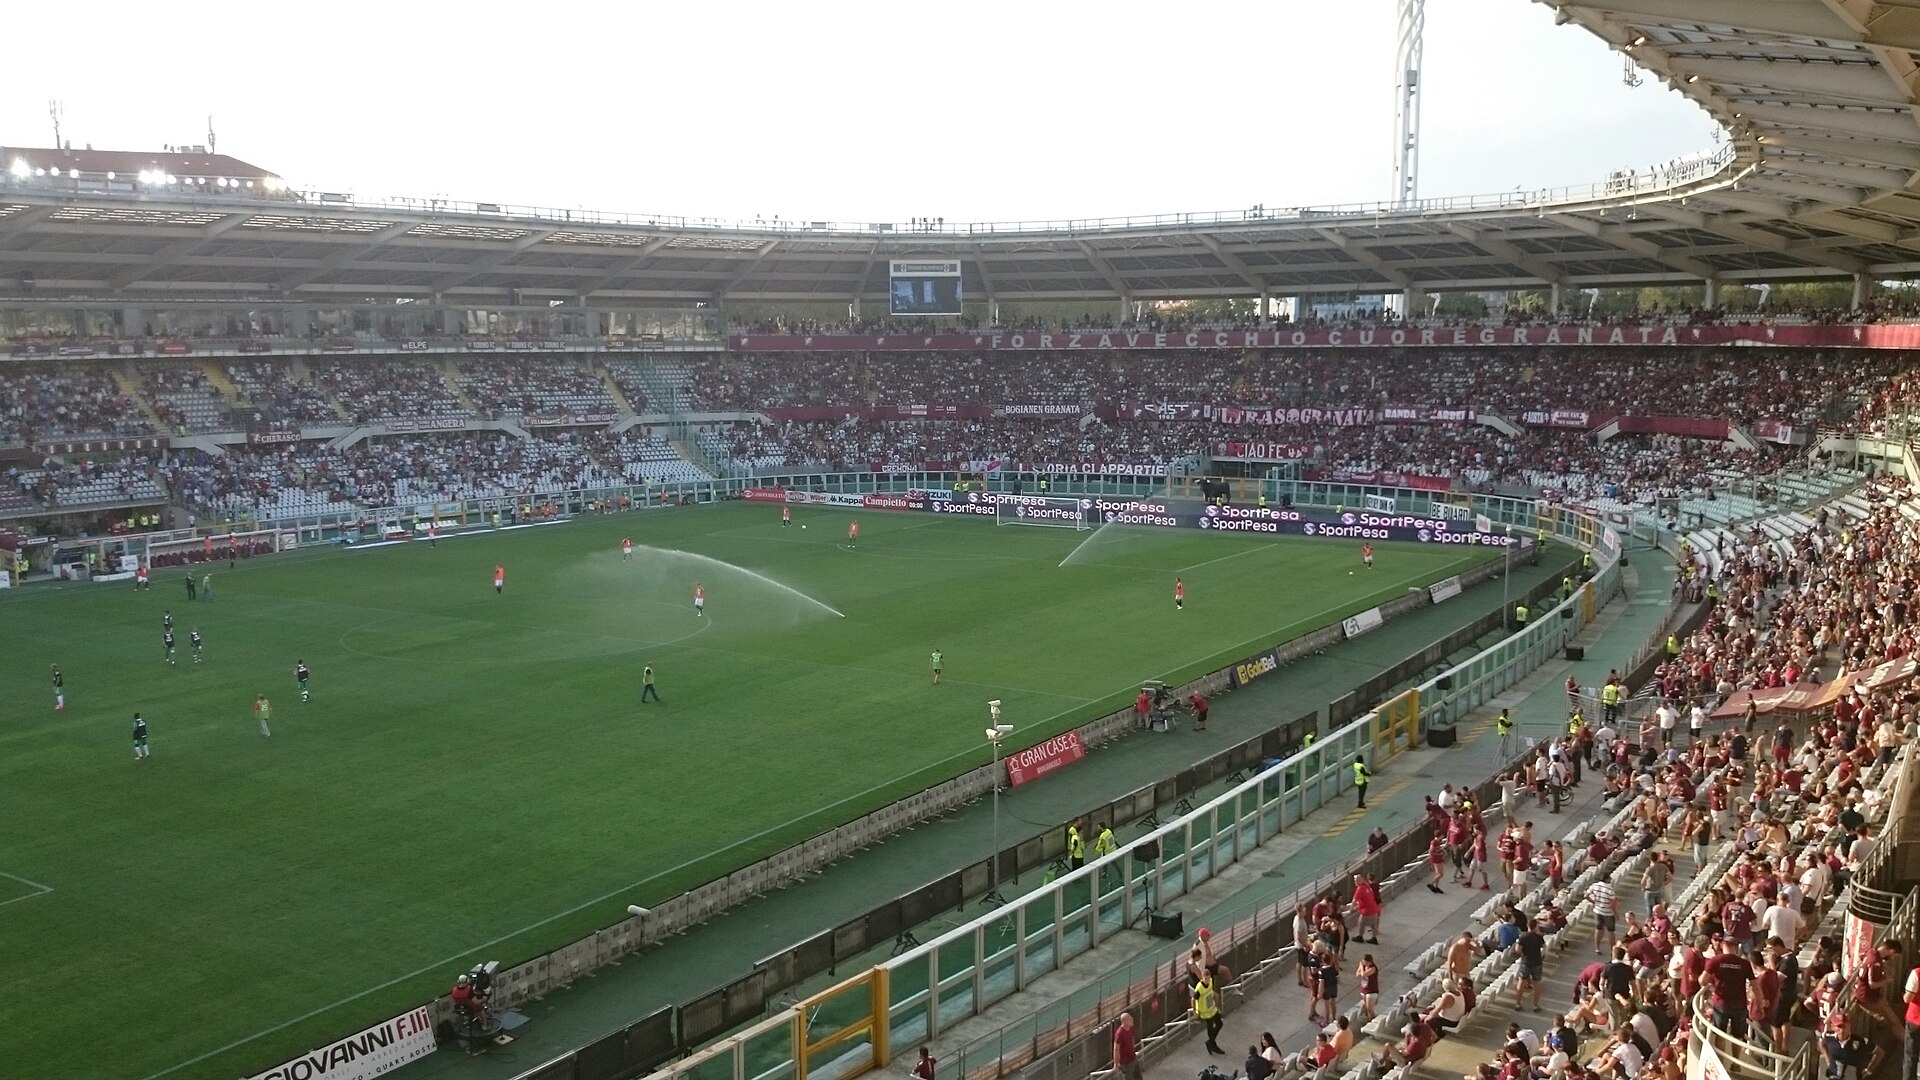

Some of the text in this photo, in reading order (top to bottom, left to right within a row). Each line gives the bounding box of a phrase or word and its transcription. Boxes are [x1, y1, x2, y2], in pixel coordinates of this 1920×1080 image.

[1005, 405, 1080, 413] BOGIANEN GRANATA
[430, 419, 465, 429] ANGERA
[261, 434, 301, 443] CHERASCO
[838, 496, 863, 505] Kappa
[865, 496, 907, 507] Campiello
[982, 493, 1046, 506] SportPesa
[1095, 499, 1165, 513] SportPesa
[943, 501, 995, 514] SportPesa
[1028, 506, 1082, 520] SportPesa
[1222, 505, 1299, 520] SportPesa
[1118, 512, 1176, 526] SportPesa
[1212, 518, 1277, 532] SportPesa
[1360, 513, 1447, 529] SportPesa
[1319, 523, 1388, 538] SportPesa
[1434, 529, 1508, 545] SportPesa
[1247, 654, 1276, 678] GoldBet
[1020, 745, 1047, 767] GRAN
[1046, 736, 1069, 756] CASE
[376, 1042, 437, 1073] QUART AOSTA
